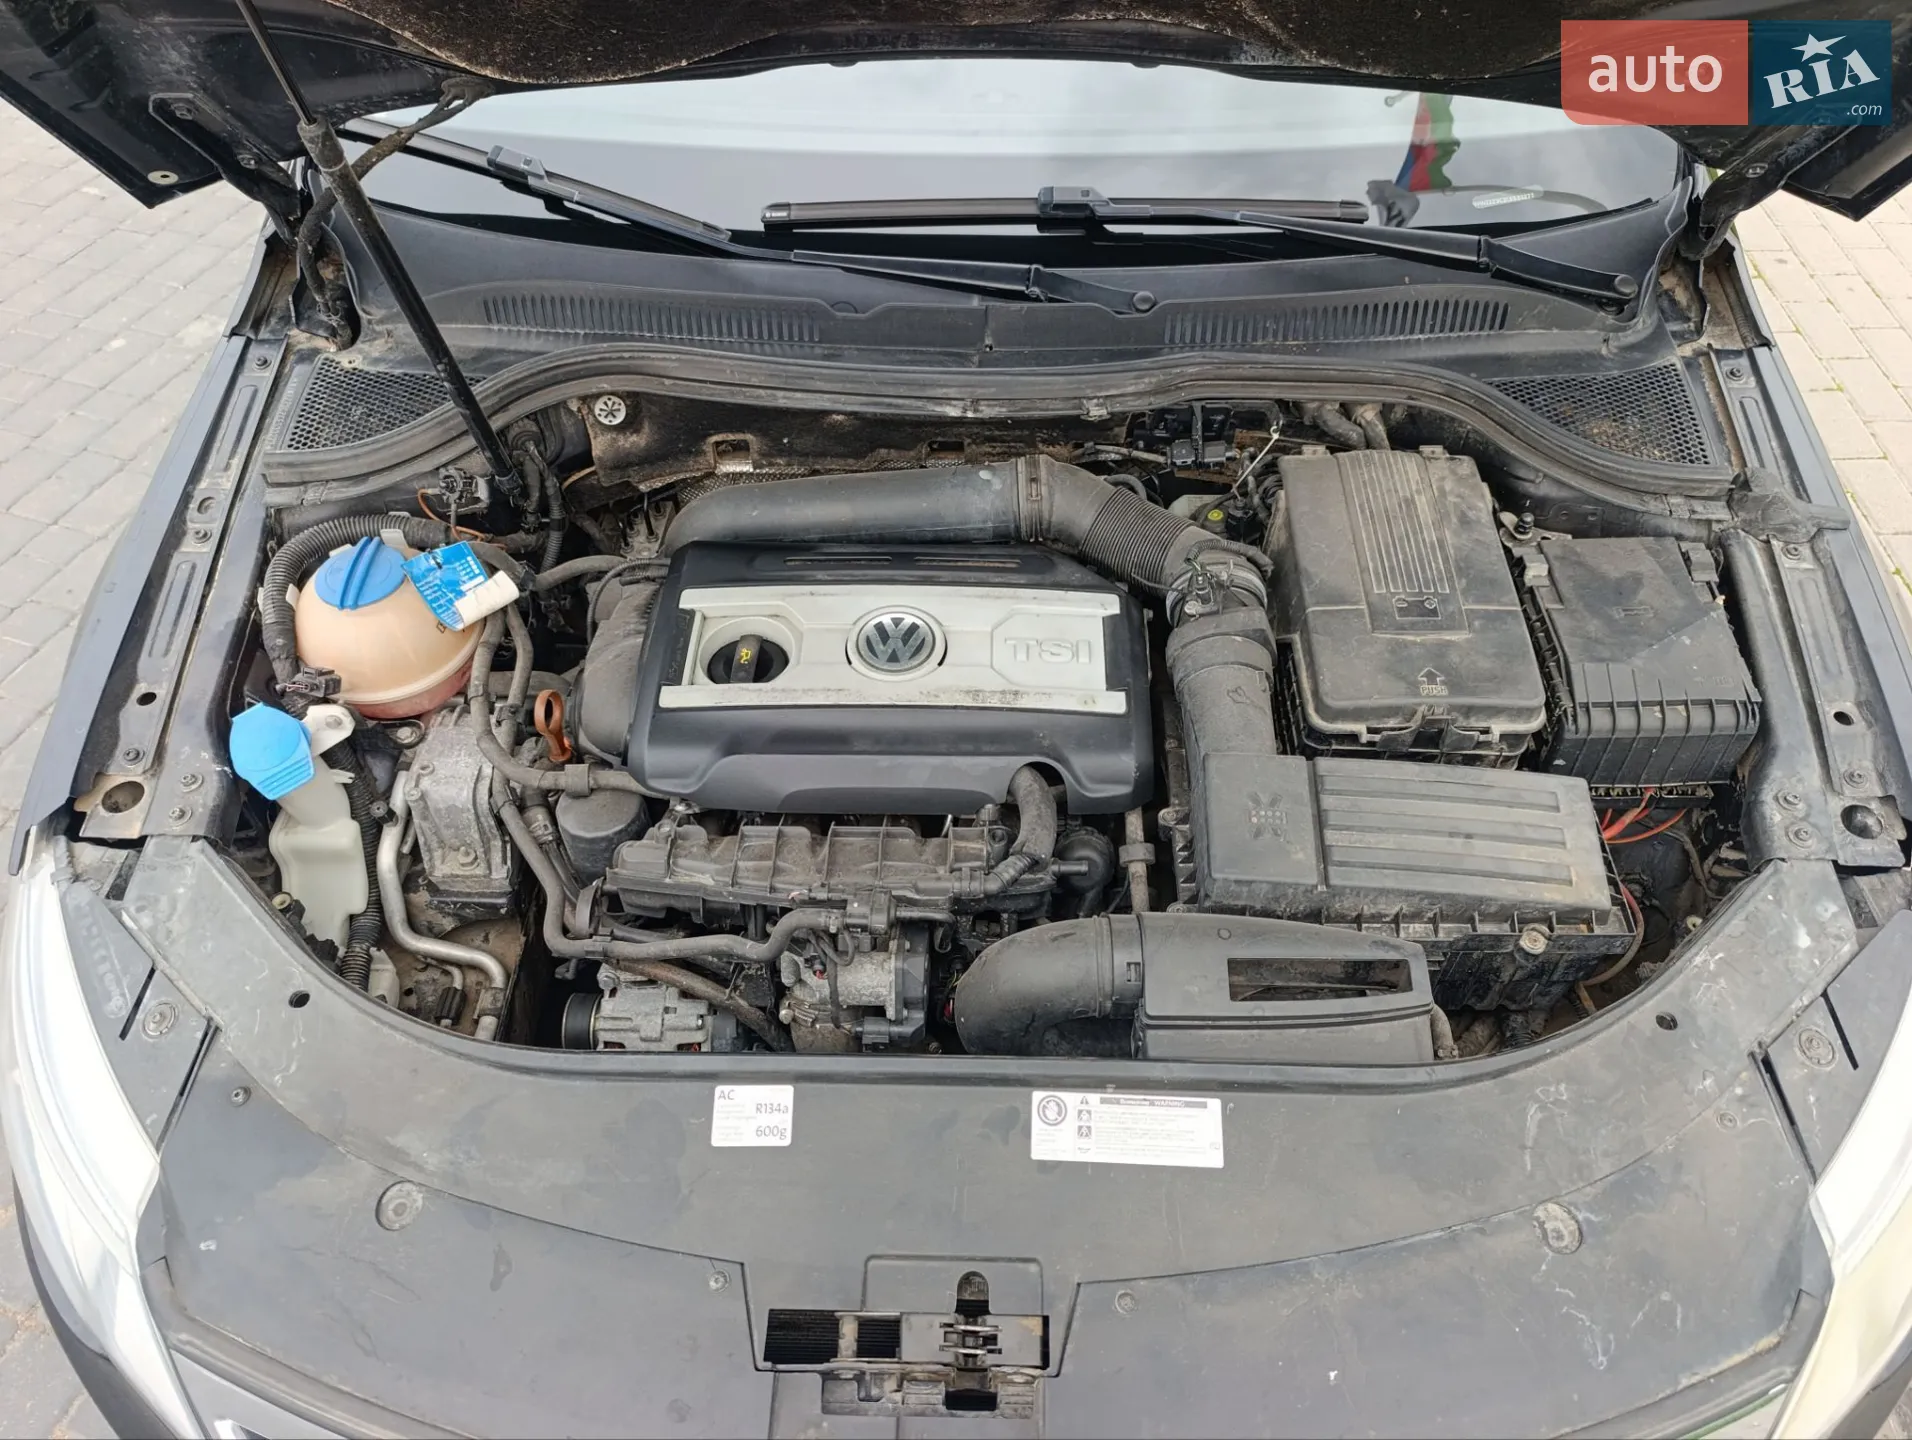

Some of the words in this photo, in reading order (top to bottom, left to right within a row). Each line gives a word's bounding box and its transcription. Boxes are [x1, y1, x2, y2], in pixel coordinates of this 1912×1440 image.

[1004, 637, 1092, 663] TSI
[1420, 685, 1449, 697] PUSH
[717, 1089, 735, 1101] AC
[755, 1103, 789, 1115] R134a
[755, 1125, 787, 1141] 600g
